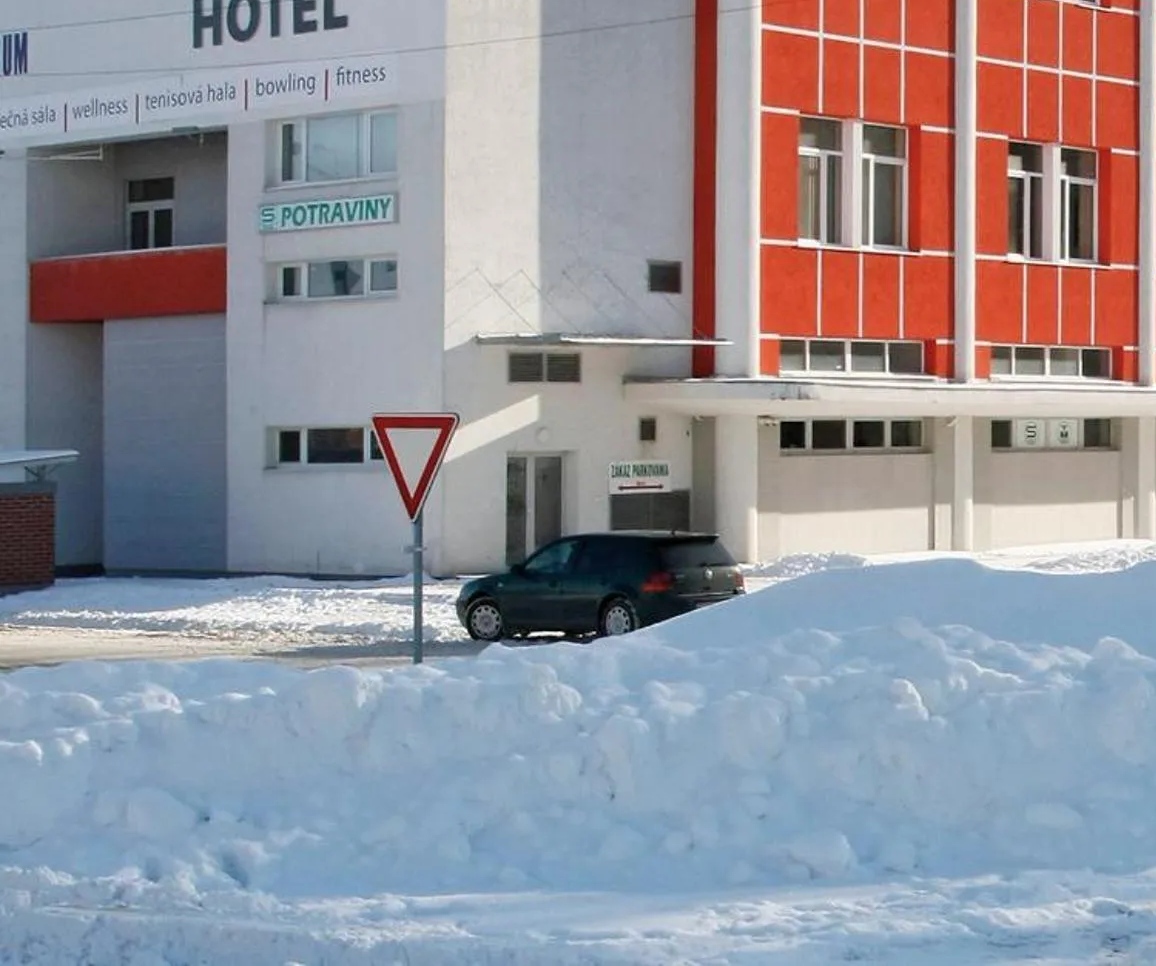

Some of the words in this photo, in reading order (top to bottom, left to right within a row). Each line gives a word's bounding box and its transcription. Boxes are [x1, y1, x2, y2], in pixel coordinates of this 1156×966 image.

[72, 97, 128, 120] wellness
[255, 74, 316, 95] bowling
[336, 65, 387, 86] fitness
[281, 198, 392, 227] POTRAVINY
